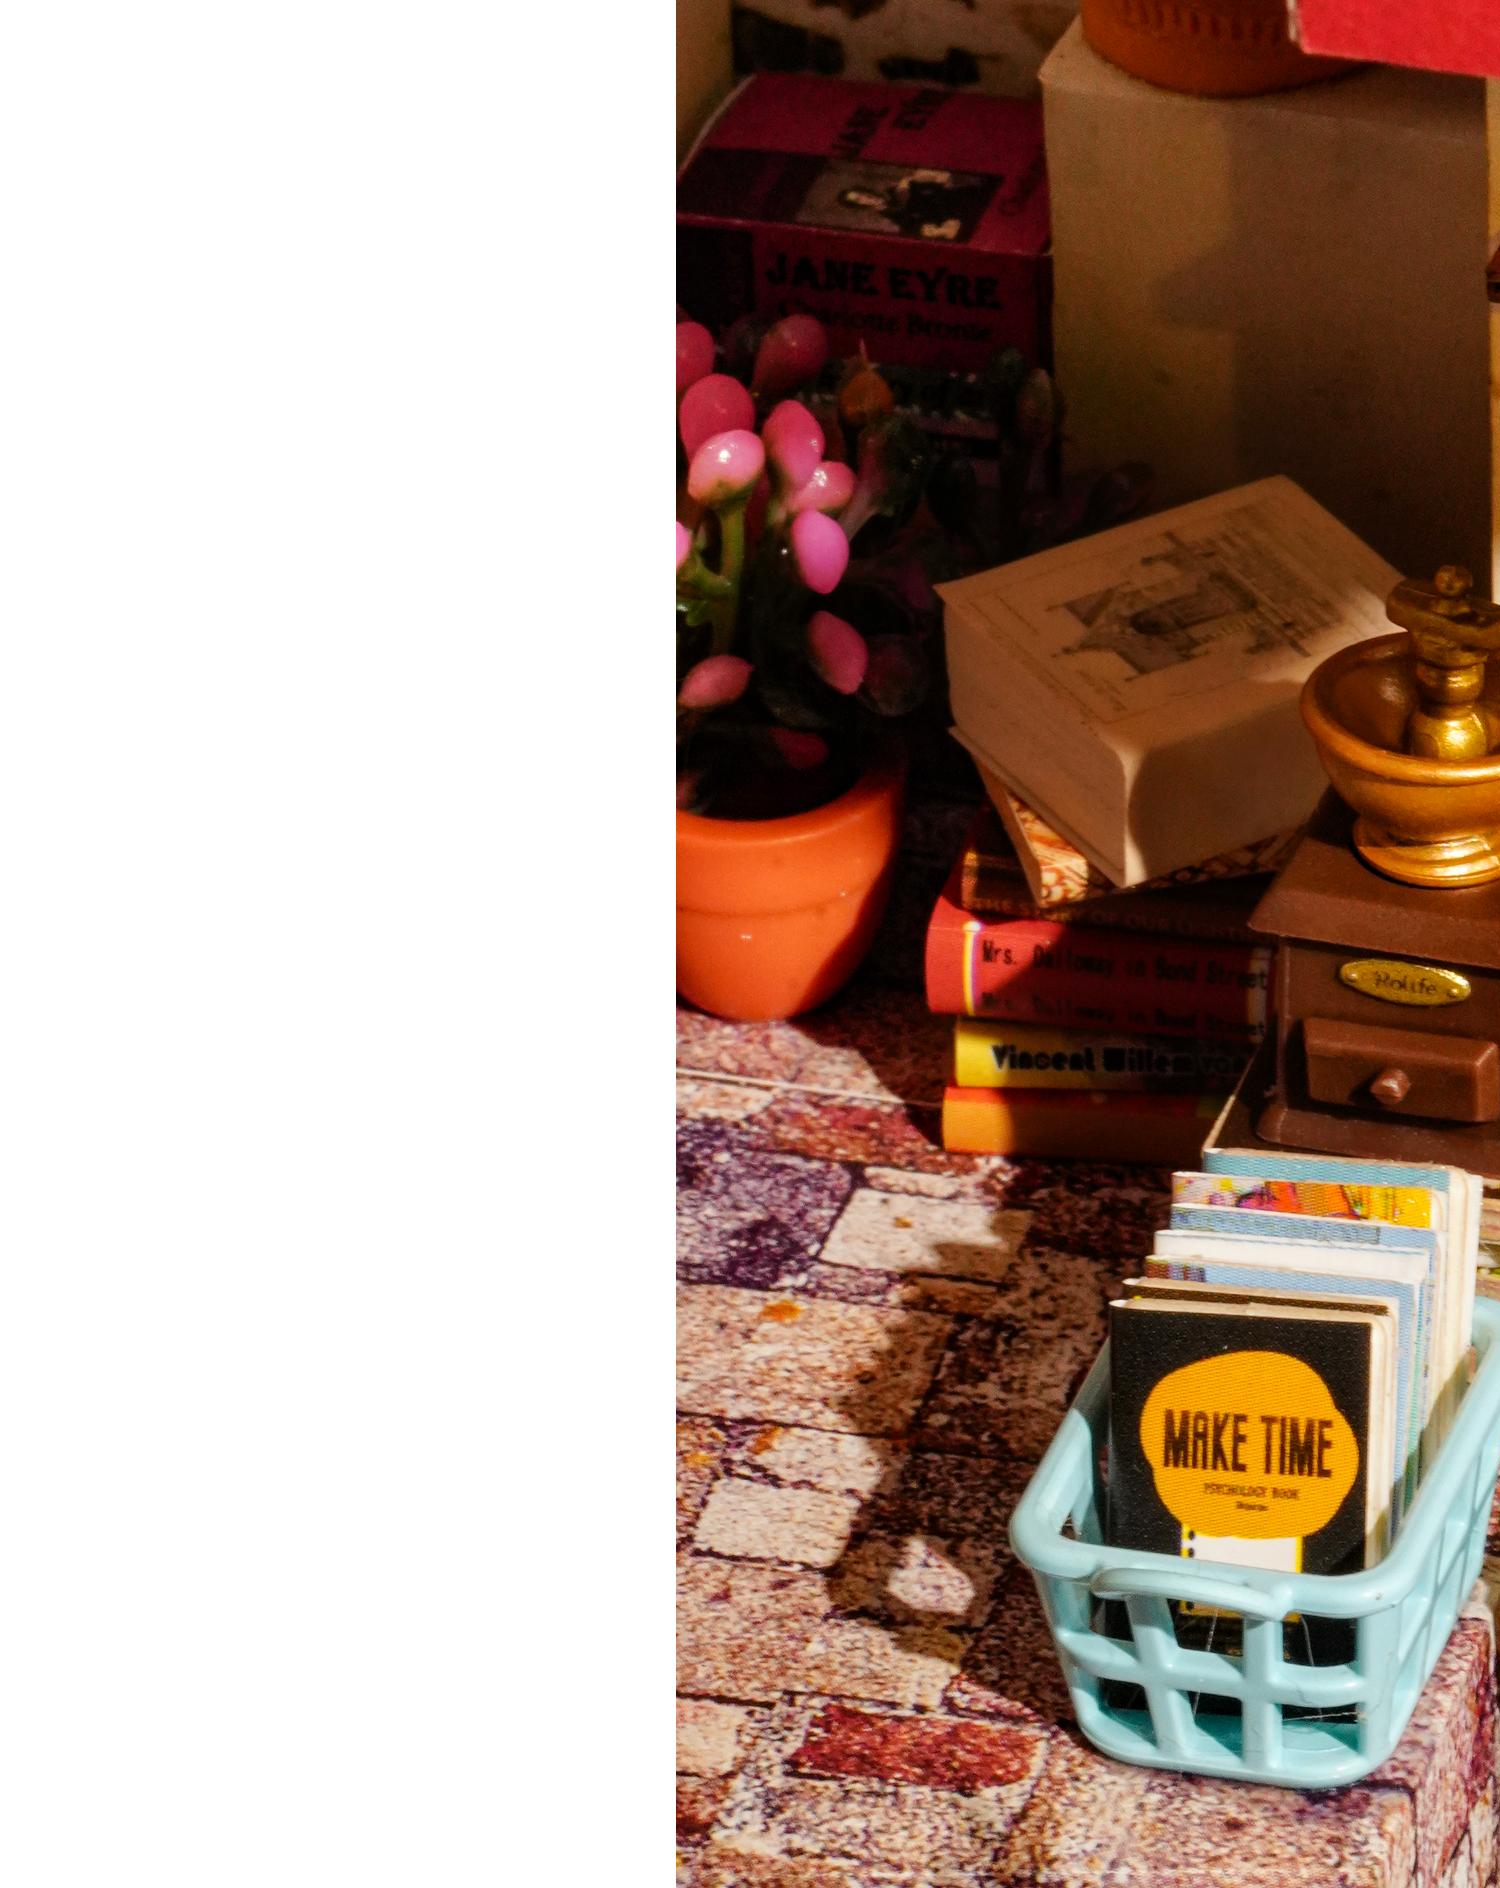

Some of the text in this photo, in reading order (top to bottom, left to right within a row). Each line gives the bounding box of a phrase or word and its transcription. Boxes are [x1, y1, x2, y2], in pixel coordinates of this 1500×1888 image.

[765, 253, 1004, 310] JANE EYRE
[981, 939, 1017, 966] Mrs.
[1031, 944, 1115, 977] Dalloway
[1154, 955, 1197, 982] Bond
[1205, 960, 1267, 990] Street
[992, 1044, 1096, 1072] Vincent
[1102, 1046, 1196, 1073] Willem
[1163, 1408, 1334, 1479] MAKE TIME
